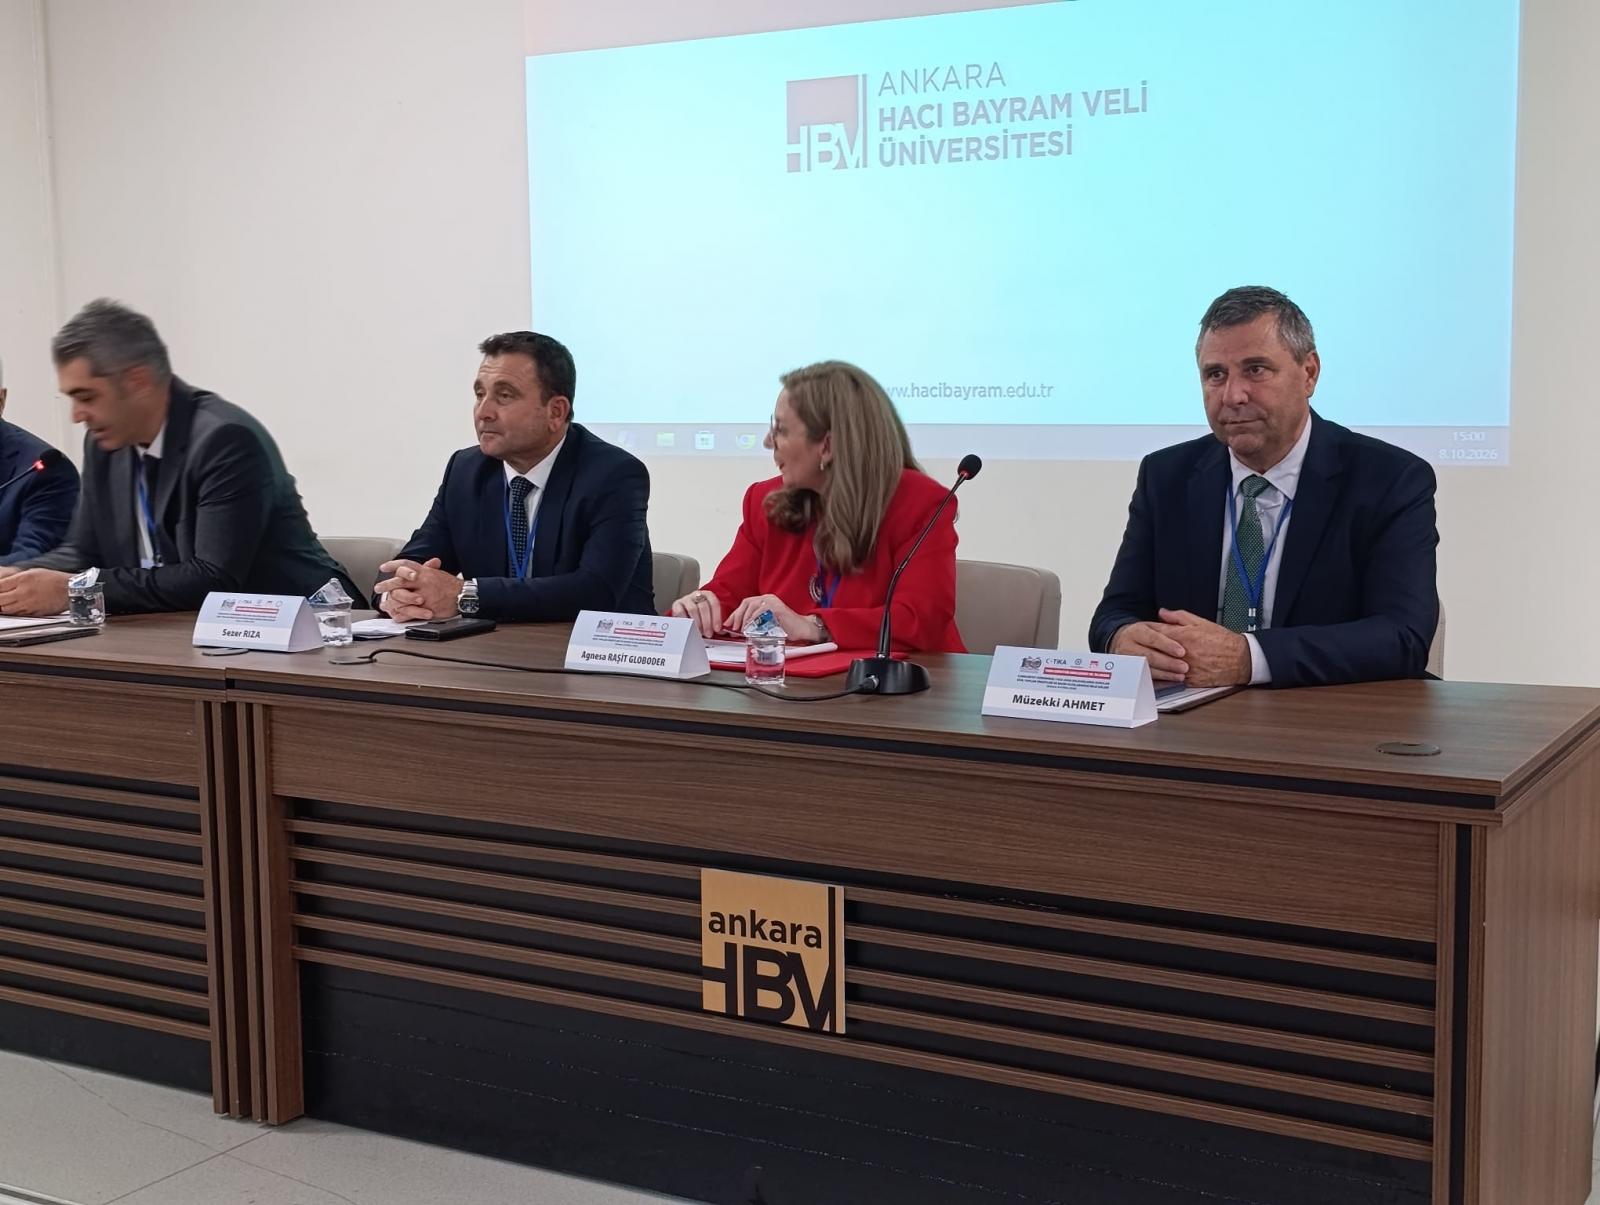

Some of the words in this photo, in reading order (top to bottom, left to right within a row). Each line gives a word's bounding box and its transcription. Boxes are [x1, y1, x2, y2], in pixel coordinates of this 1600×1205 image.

[878, 62, 1006, 97] ANKARA
[878, 103, 943, 132] HACI
[953, 93, 1073, 124] BAYRAM
[1082, 80, 1148, 117] VELİ
[878, 124, 1073, 168] ÜNİVERSİTESİ
[222, 628, 242, 638] Sezer
[243, 629, 260, 639] RIZA
[581, 650, 607, 662] Agnesa
[608, 652, 628, 665] RAŞİT
[629, 655, 666, 667] GLOBODER
[1012, 694, 1060, 708] Müzekki
[1062, 699, 1106, 712] AHMET
[708, 909, 822, 949] ankara
